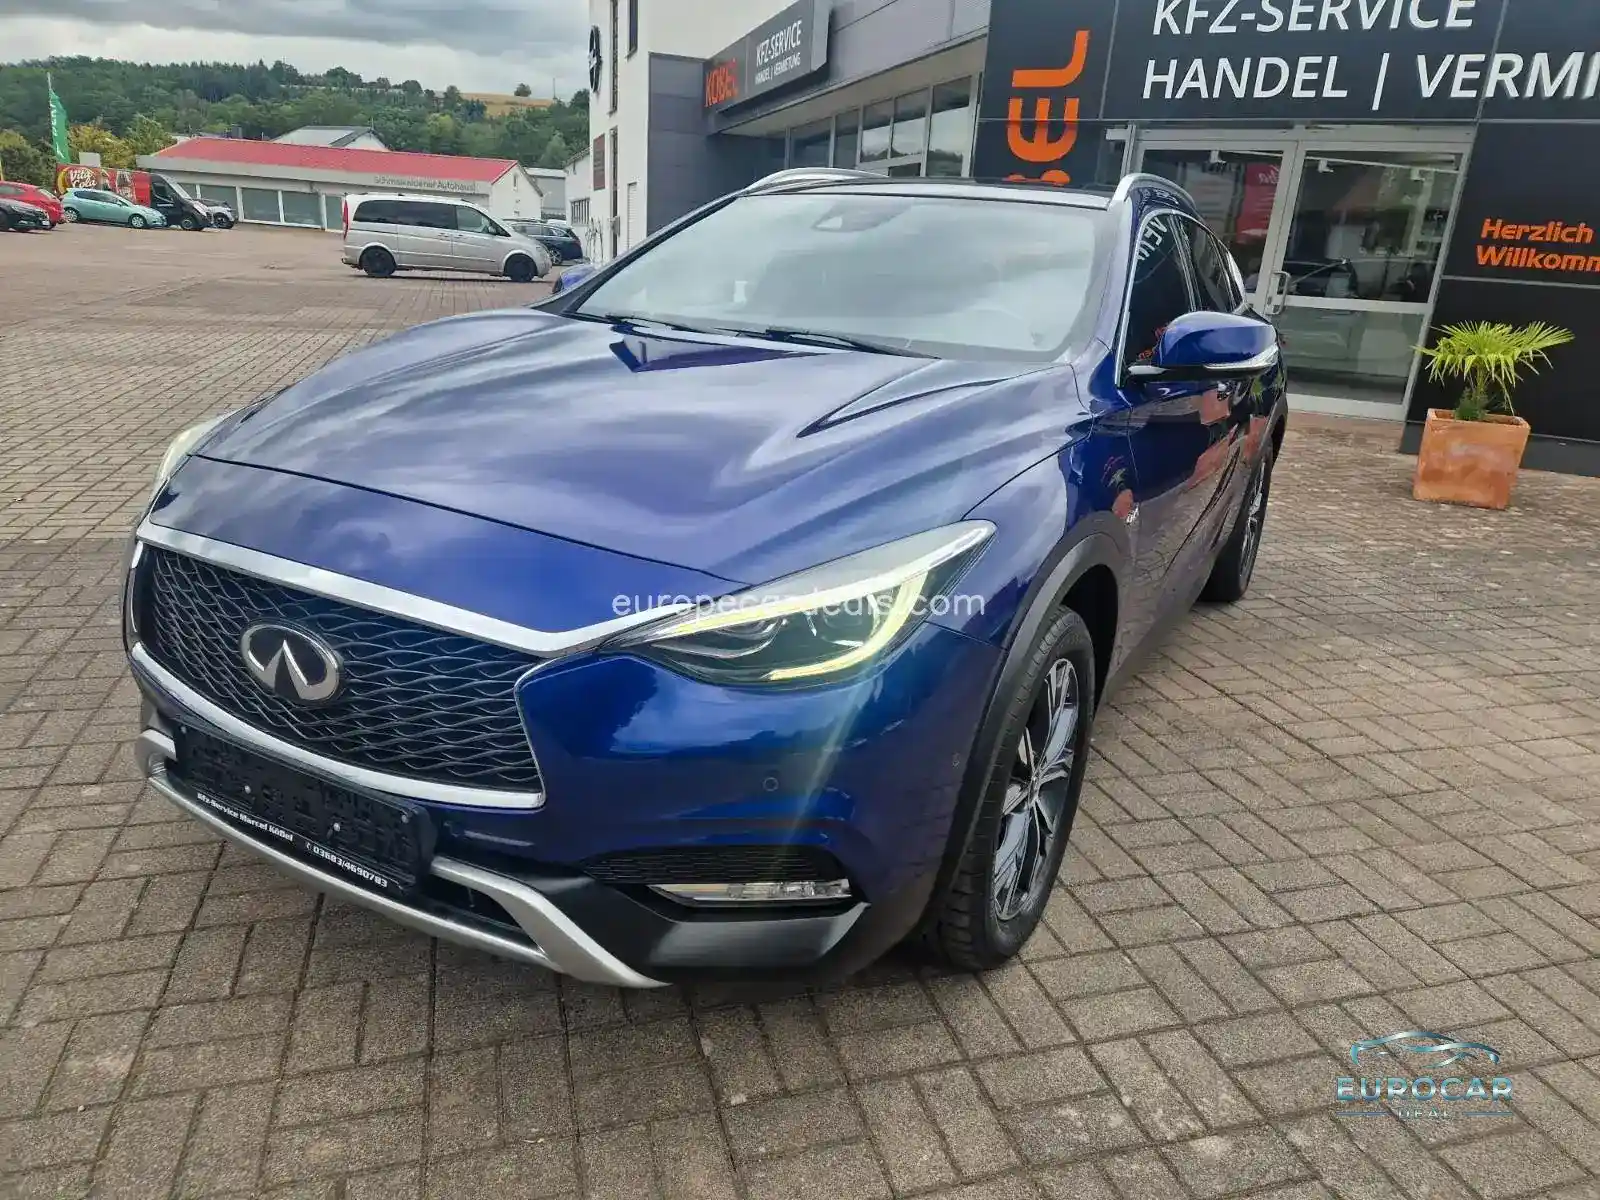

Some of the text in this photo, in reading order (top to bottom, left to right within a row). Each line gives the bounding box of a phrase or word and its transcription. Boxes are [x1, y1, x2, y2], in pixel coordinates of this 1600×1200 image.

[1153, 0, 1476, 35] KFZ-SERVICE
[756, 20, 802, 67] KFZ-SERVICE
[1142, 56, 1348, 99] HANDEL
[1481, 218, 1595, 244] Herzlich
[239, 813, 268, 831] Marcel
